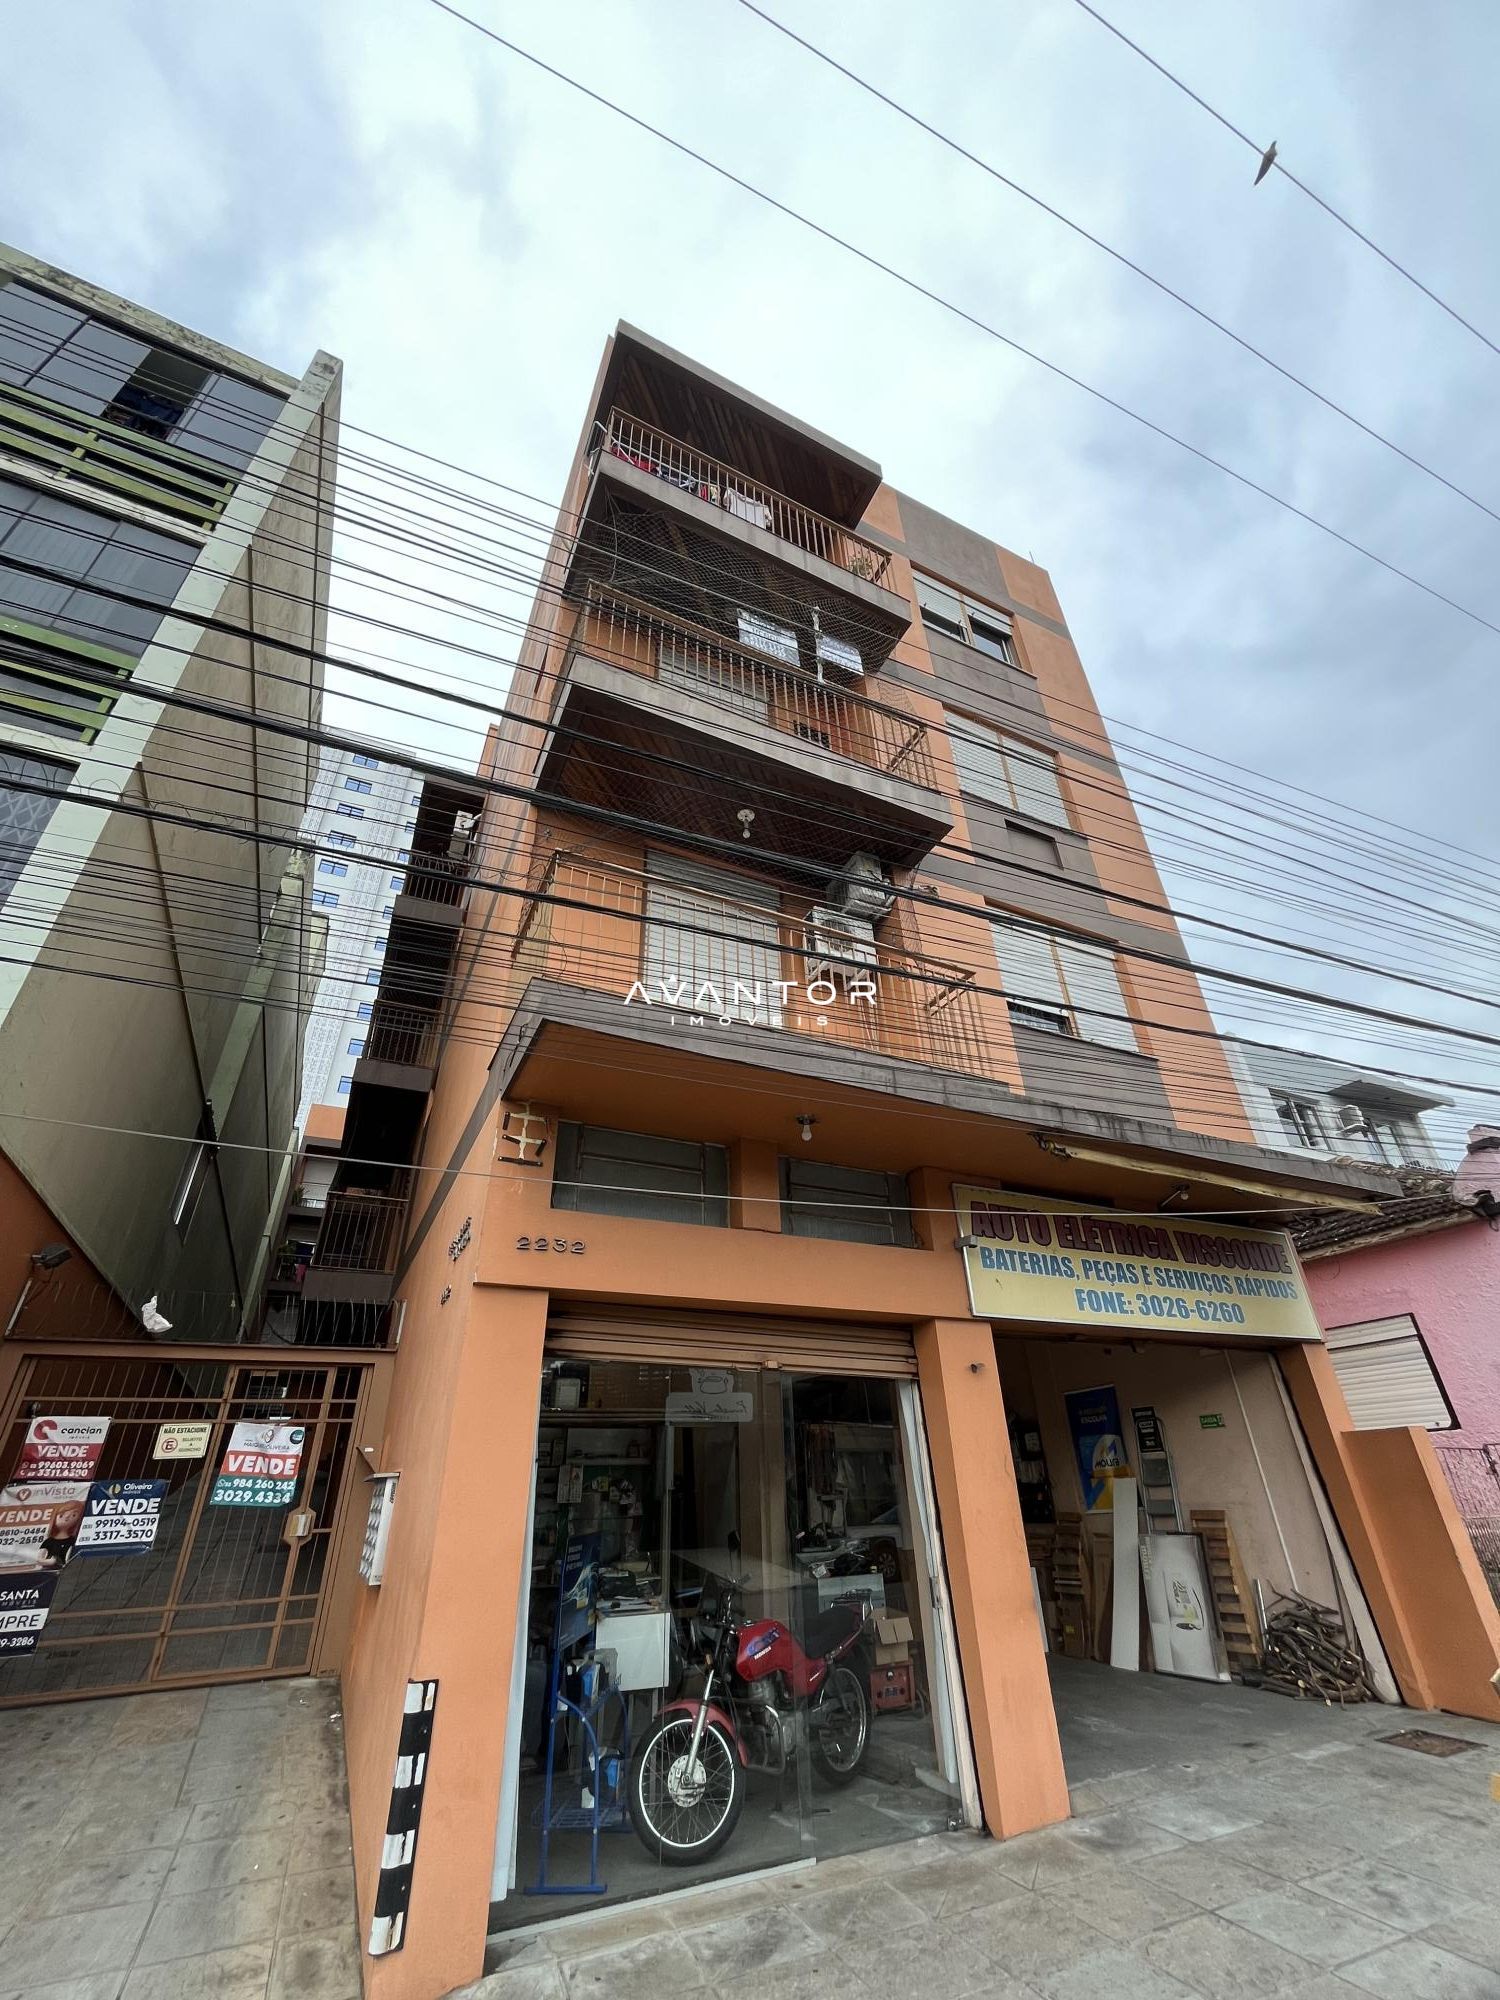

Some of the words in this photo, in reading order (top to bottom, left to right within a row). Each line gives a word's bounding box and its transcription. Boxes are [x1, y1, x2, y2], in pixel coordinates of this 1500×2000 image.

[970, 1200, 1052, 1247] AUTO
[1173, 1230, 1293, 1274] VISCONDE
[516, 1236, 586, 1255] 2232
[979, 1246, 1081, 1281] BATERIAS,
[1081, 1258, 1140, 1286] PEÇAS
[1140, 1264, 1151, 1286] E
[1153, 1266, 1235, 1296] SERVIÇOS
[1233, 1273, 1299, 1300] RÁPIDOS
[1074, 1288, 1135, 1315] FONE:
[1135, 1293, 1246, 1324] 3026-6260
[163, 1426, 176, 1434] NÃO
[176, 1426, 208, 1434] ESTACIONE
[37, 1445, 90, 1458] VENDE
[228, 1454, 297, 1476] VENDE
[233, 1478, 253, 1488] 984
[254, 1479, 274, 1489] 260
[275, 1481, 296, 1491] 242
[214, 1489, 291, 1504] 3029.4334
[91, 1497, 161, 1515] VENDE
[95, 1517, 157, 1529] 99194-0519
[92, 1528, 153, 1541] 3317-3570
[0, 1589, 40, 1601] SANTA
